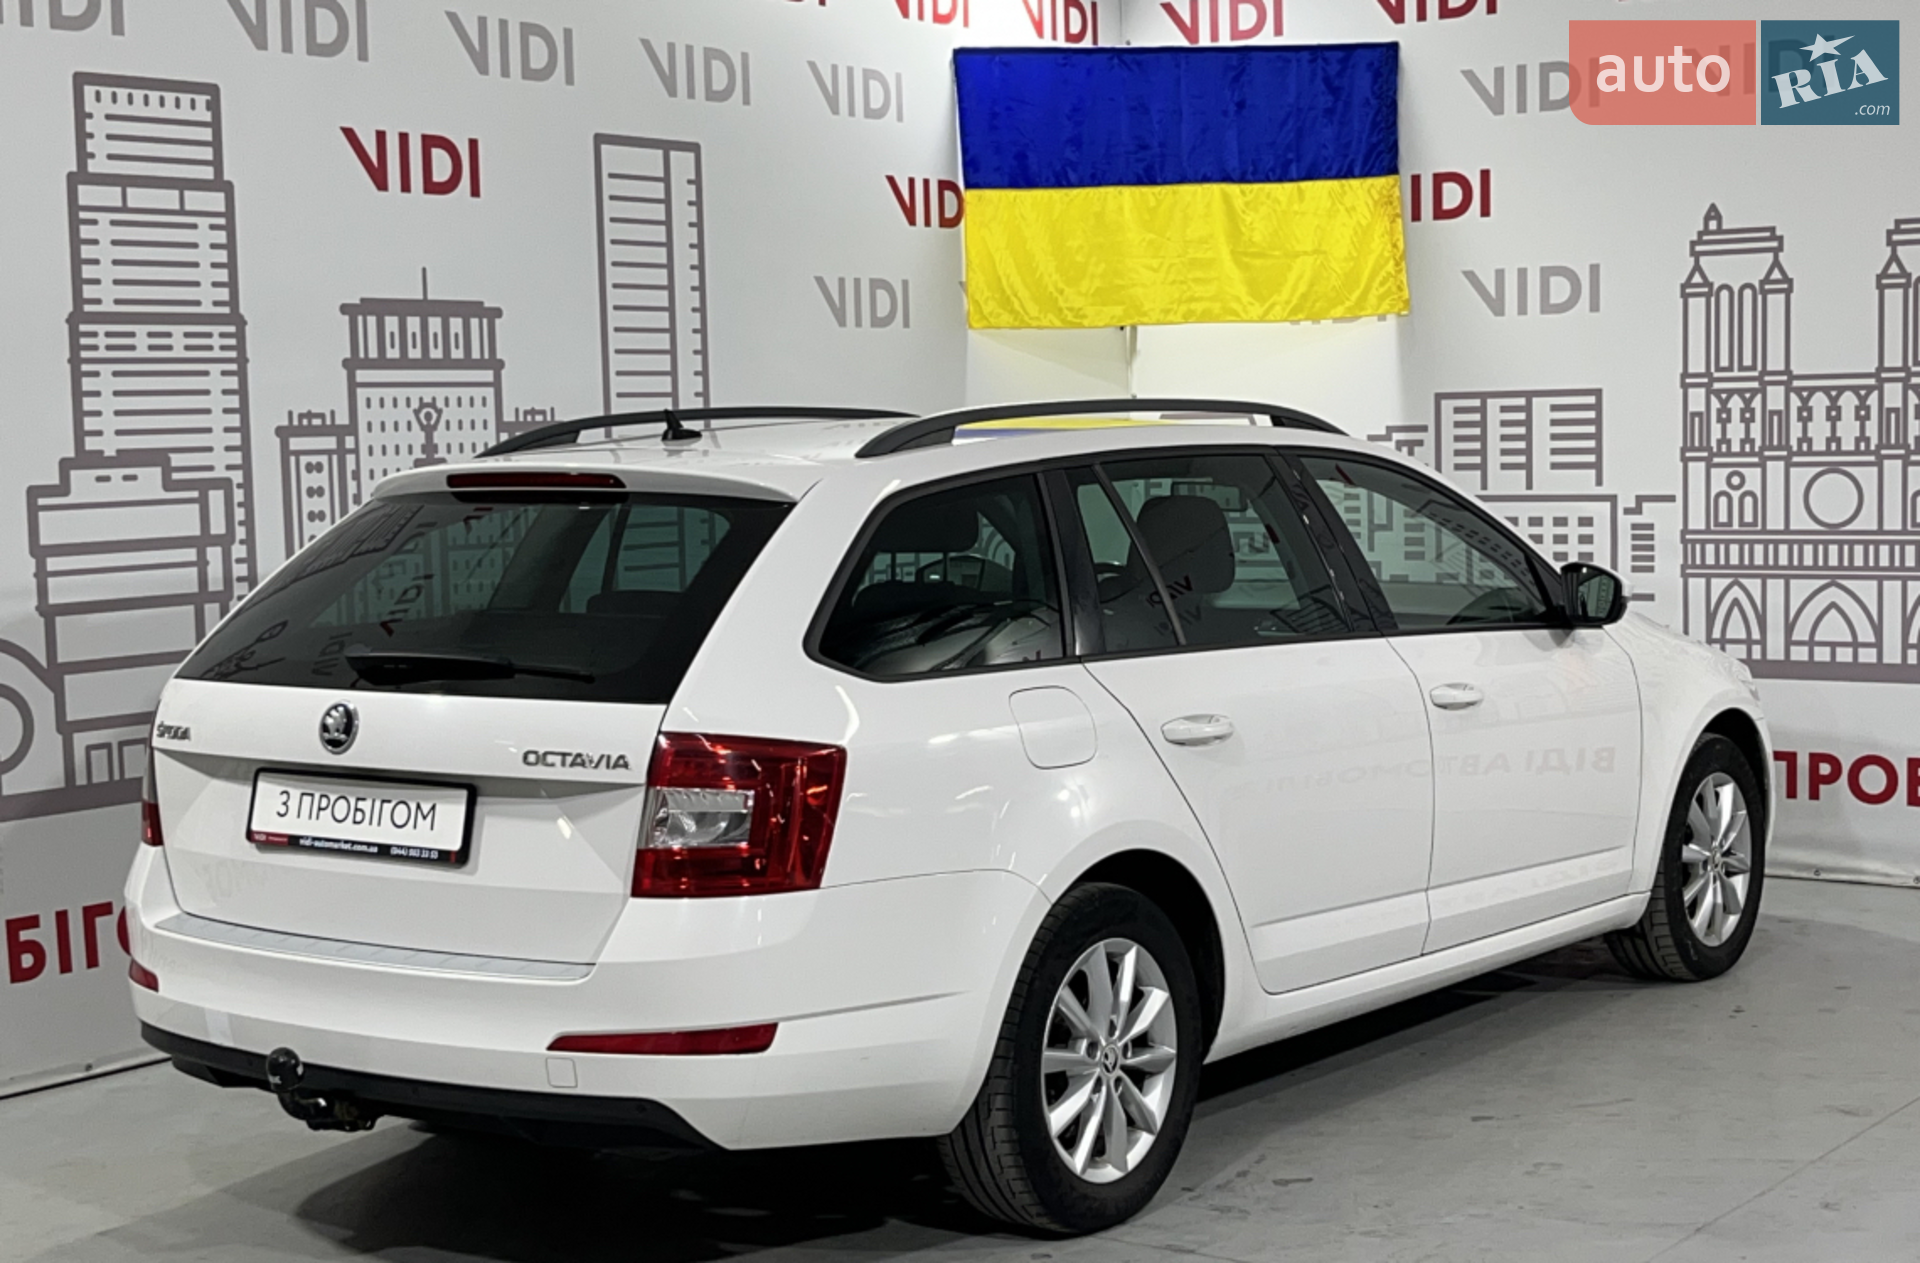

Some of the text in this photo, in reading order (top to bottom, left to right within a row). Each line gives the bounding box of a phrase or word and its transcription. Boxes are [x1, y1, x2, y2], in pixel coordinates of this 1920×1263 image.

[445, 10, 575, 86] VIDI
[1022, 0, 1099, 46] VIDI
[1160, 0, 1284, 46] VIDI
[640, 38, 751, 106] VIDI
[807, 60, 904, 122] VIDI
[339, 126, 481, 198] VIDI
[886, 174, 966, 230] VID
[1410, 168, 1492, 222] IDI
[814, 275, 911, 329] VIDI
[1461, 263, 1601, 317] VIDI
[522, 749, 631, 771] OCTAVIA
[296, 791, 437, 832] ПРОБІГОМ
[5, 901, 132, 984] БІГ
